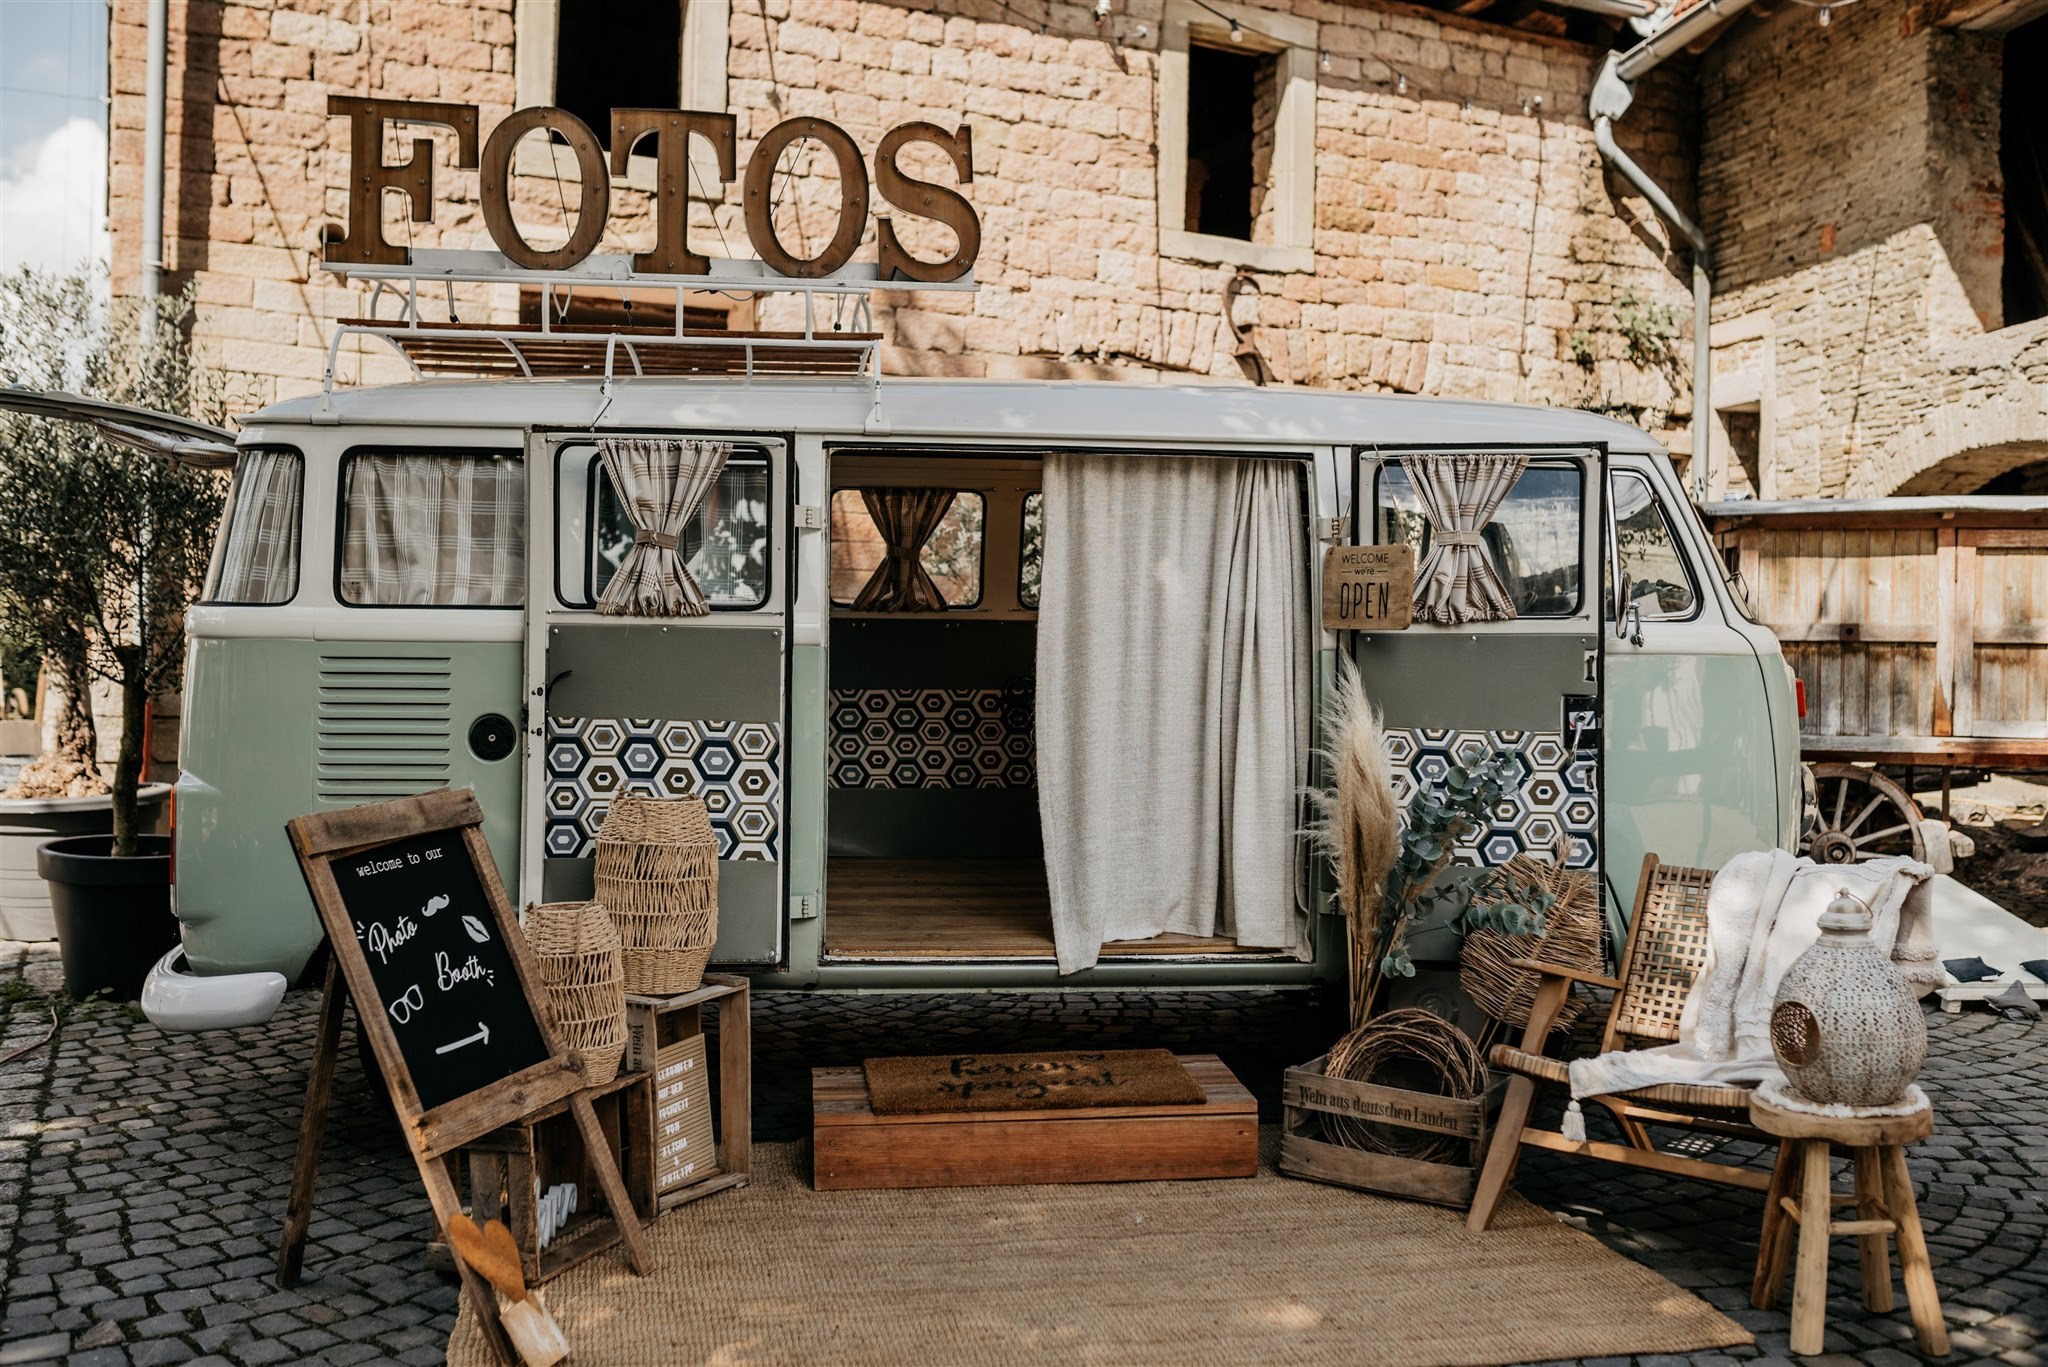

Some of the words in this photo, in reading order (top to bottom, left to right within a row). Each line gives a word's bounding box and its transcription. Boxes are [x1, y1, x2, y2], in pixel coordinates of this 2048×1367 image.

[325, 95, 981, 283] FOTOS
[1341, 552, 1389, 564] WELCOME
[1354, 566, 1375, 575] we're
[1340, 581, 1389, 619] OPEN
[356, 856, 403, 878] welcome
[407, 852, 421, 865] to
[425, 847, 443, 861] our
[368, 915, 418, 965] Photo
[435, 951, 486, 991] Booth
[1299, 1085, 1327, 1106] Wein
[1329, 1094, 1350, 1110] aus
[1352, 1096, 1411, 1121] deutschen
[1413, 1106, 1458, 1130] Landen
[665, 1120, 681, 1136] VON
[662, 1162, 694, 1187] PHILIPP
